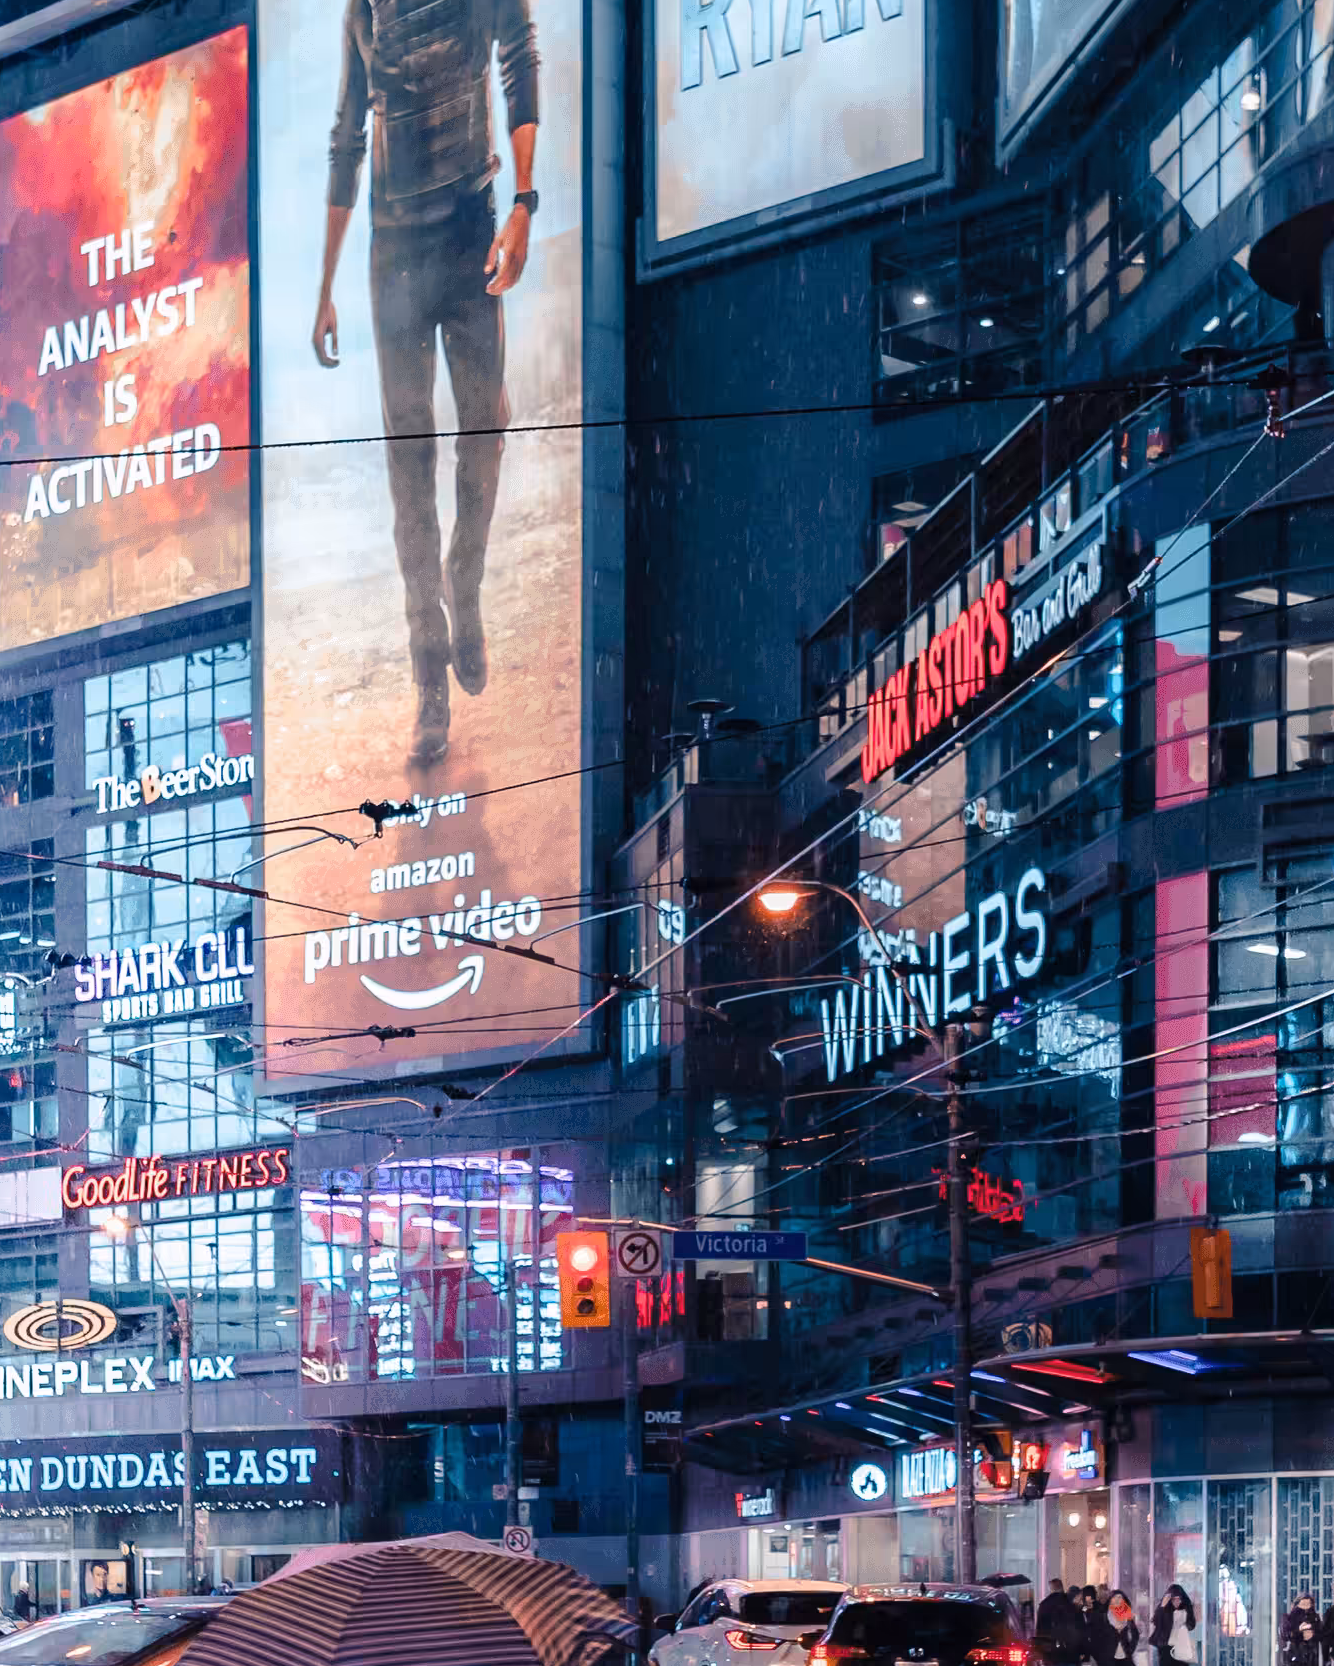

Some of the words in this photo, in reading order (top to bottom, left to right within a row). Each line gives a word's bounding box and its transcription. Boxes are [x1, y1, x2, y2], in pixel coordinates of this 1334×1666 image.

[81, 220, 155, 287] THE
[38, 278, 203, 376] ANALYST
[104, 375, 138, 427] IS
[24, 423, 221, 522] ACTIVATED
[861, 662, 912, 784] JACK
[915, 578, 1008, 742] ASTOR'S
[92, 774, 140, 814] The
[141, 765, 199, 805] Beer
[199, 753, 254, 791] Stor
[438, 791, 466, 816] on
[370, 851, 475, 894] amazon
[304, 913, 421, 984] prime
[429, 889, 542, 950] video
[74, 939, 186, 1003] SHARK
[102, 992, 158, 1023] SPORTS
[164, 987, 195, 1014] BAR
[200, 979, 244, 1008] GRILL
[820, 868, 1046, 1083] WINNERS
[62, 1156, 168, 1210] GoodLife
[177, 1149, 289, 1196] FITNESS
[695, 1234, 768, 1254] Victoria
[644, 1410, 683, 1424] DMZ
[205, 1447, 318, 1486] EAST
